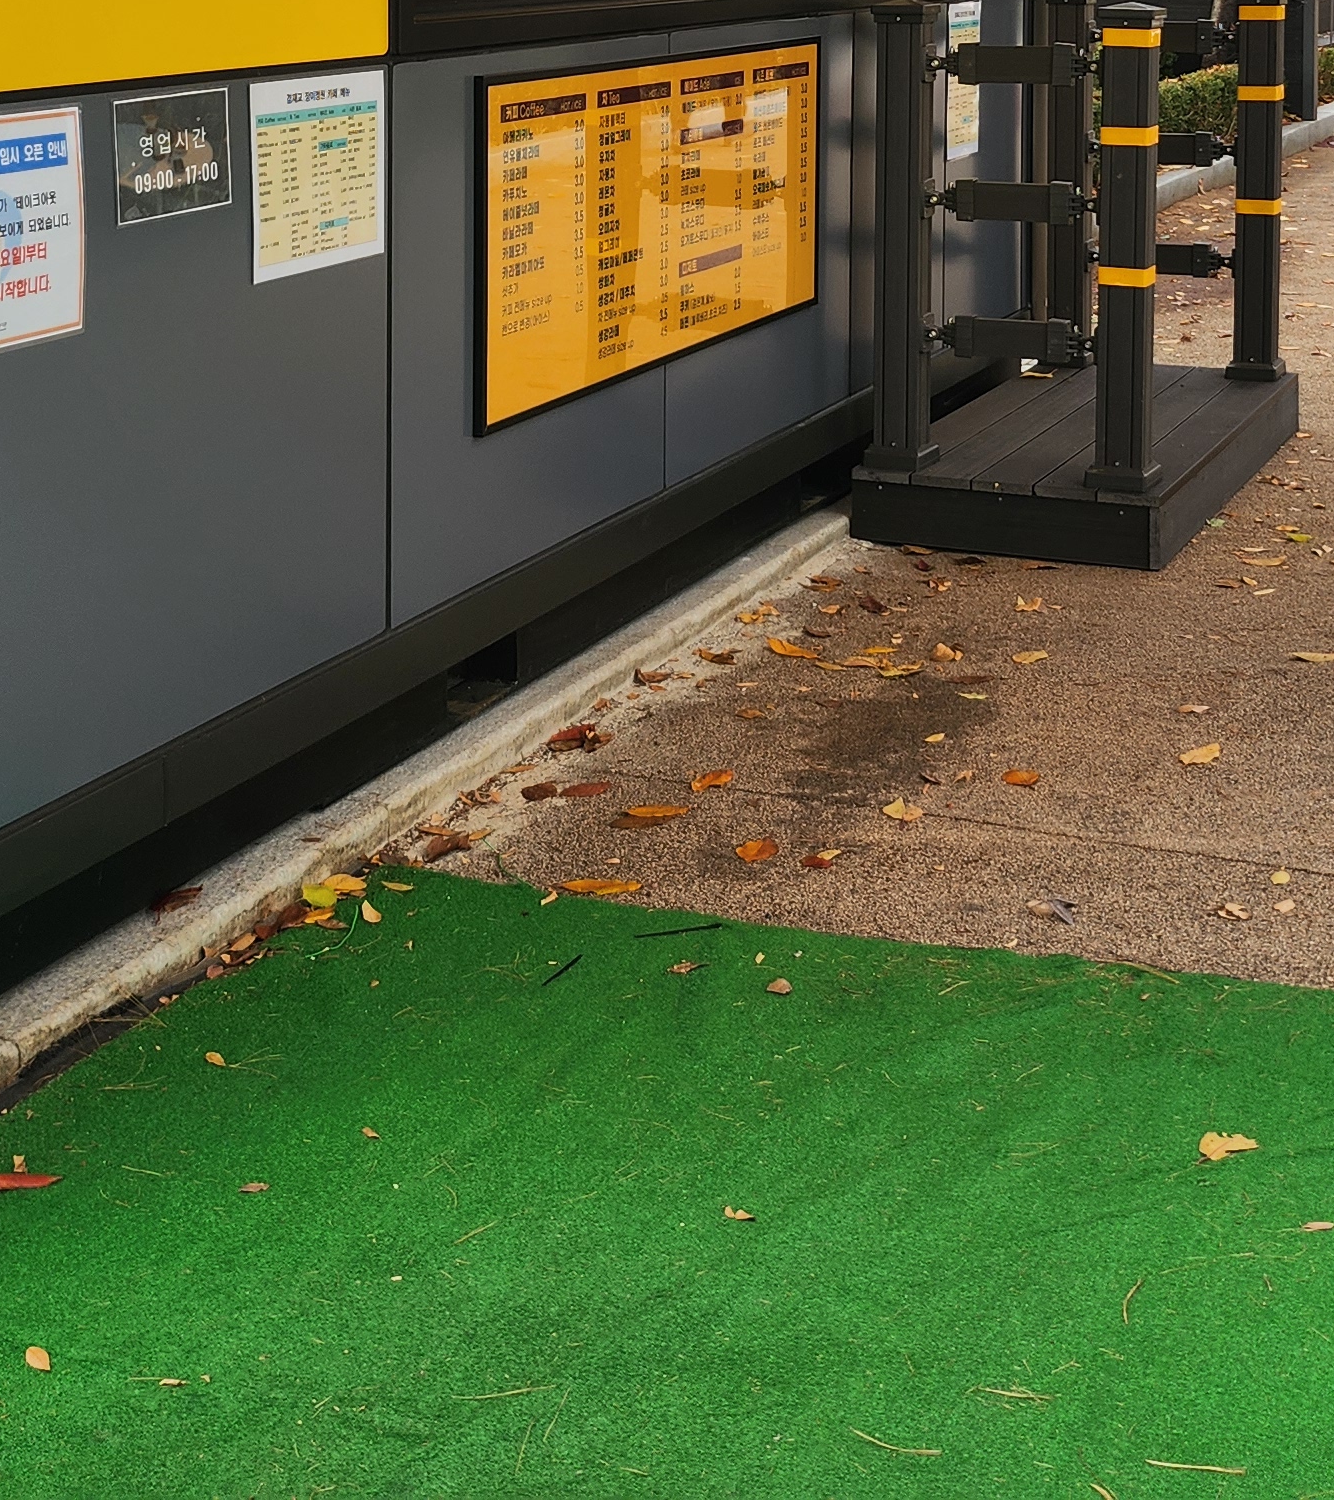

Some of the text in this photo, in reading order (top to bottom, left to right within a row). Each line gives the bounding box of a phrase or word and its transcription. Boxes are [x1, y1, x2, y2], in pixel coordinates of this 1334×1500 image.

[505, 105, 518, 120] 커피
[519, 102, 545, 118] Coffee
[139, 126, 207, 157] 영업시간
[0, 146, 20, 166] 임시
[23, 142, 44, 162] 오픈
[47, 139, 67, 159] 안내
[574, 155, 585, 169] 3.0
[134, 169, 174, 194] 09:00
[185, 161, 219, 185] 17:00
[503, 173, 585, 202] 카푸치노 3.0
[574, 191, 585, 205] 3.0
[28, 212, 71, 233] 되었습니다.
[574, 210, 584, 223] 3.5
[574, 228, 584, 242] 3.5
[574, 246, 584, 260] 3.5
[545, 294, 553, 306] up
